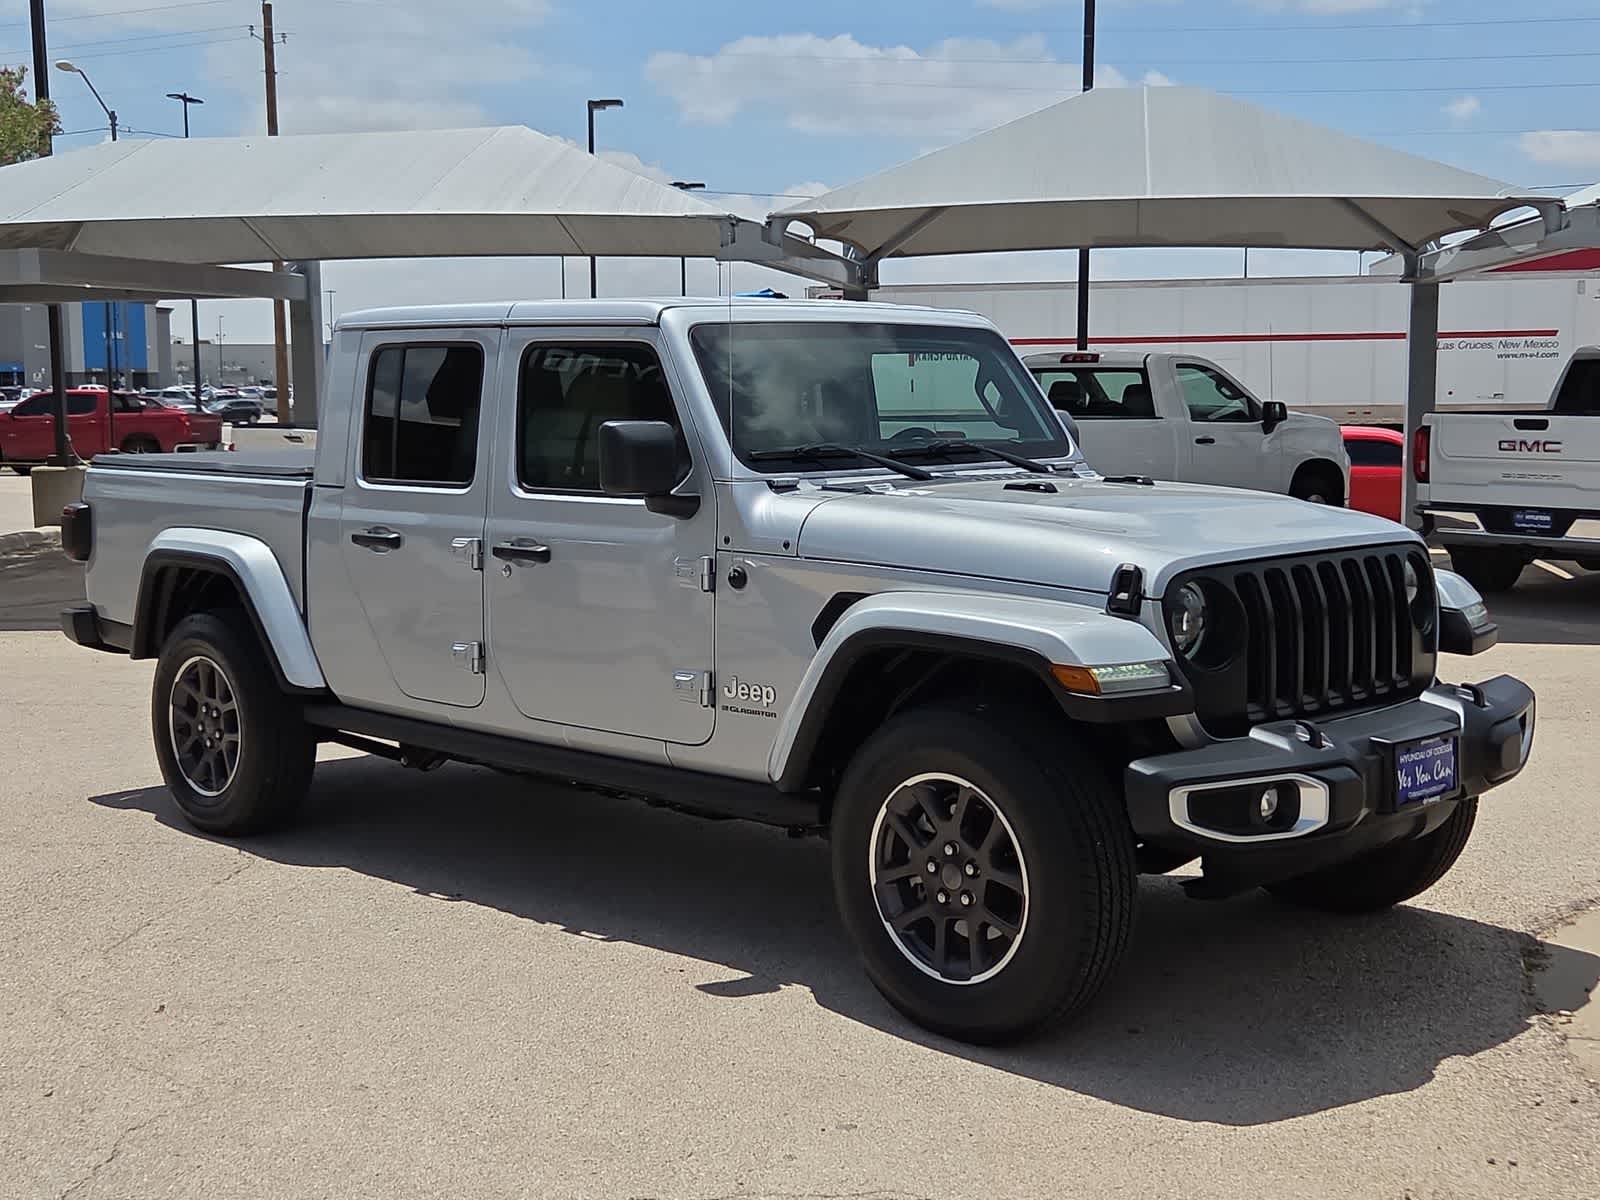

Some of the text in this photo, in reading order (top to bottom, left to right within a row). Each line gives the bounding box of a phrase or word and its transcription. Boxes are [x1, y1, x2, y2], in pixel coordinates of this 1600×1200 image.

[1436, 339, 1559, 350] Las Cruces, New Mexico
[1498, 440, 1562, 453] GMC
[723, 675, 777, 708] Jeep
[730, 705, 777, 718] GLADIATOR
[1398, 768, 1411, 790] Yes
[1415, 764, 1431, 785] You
